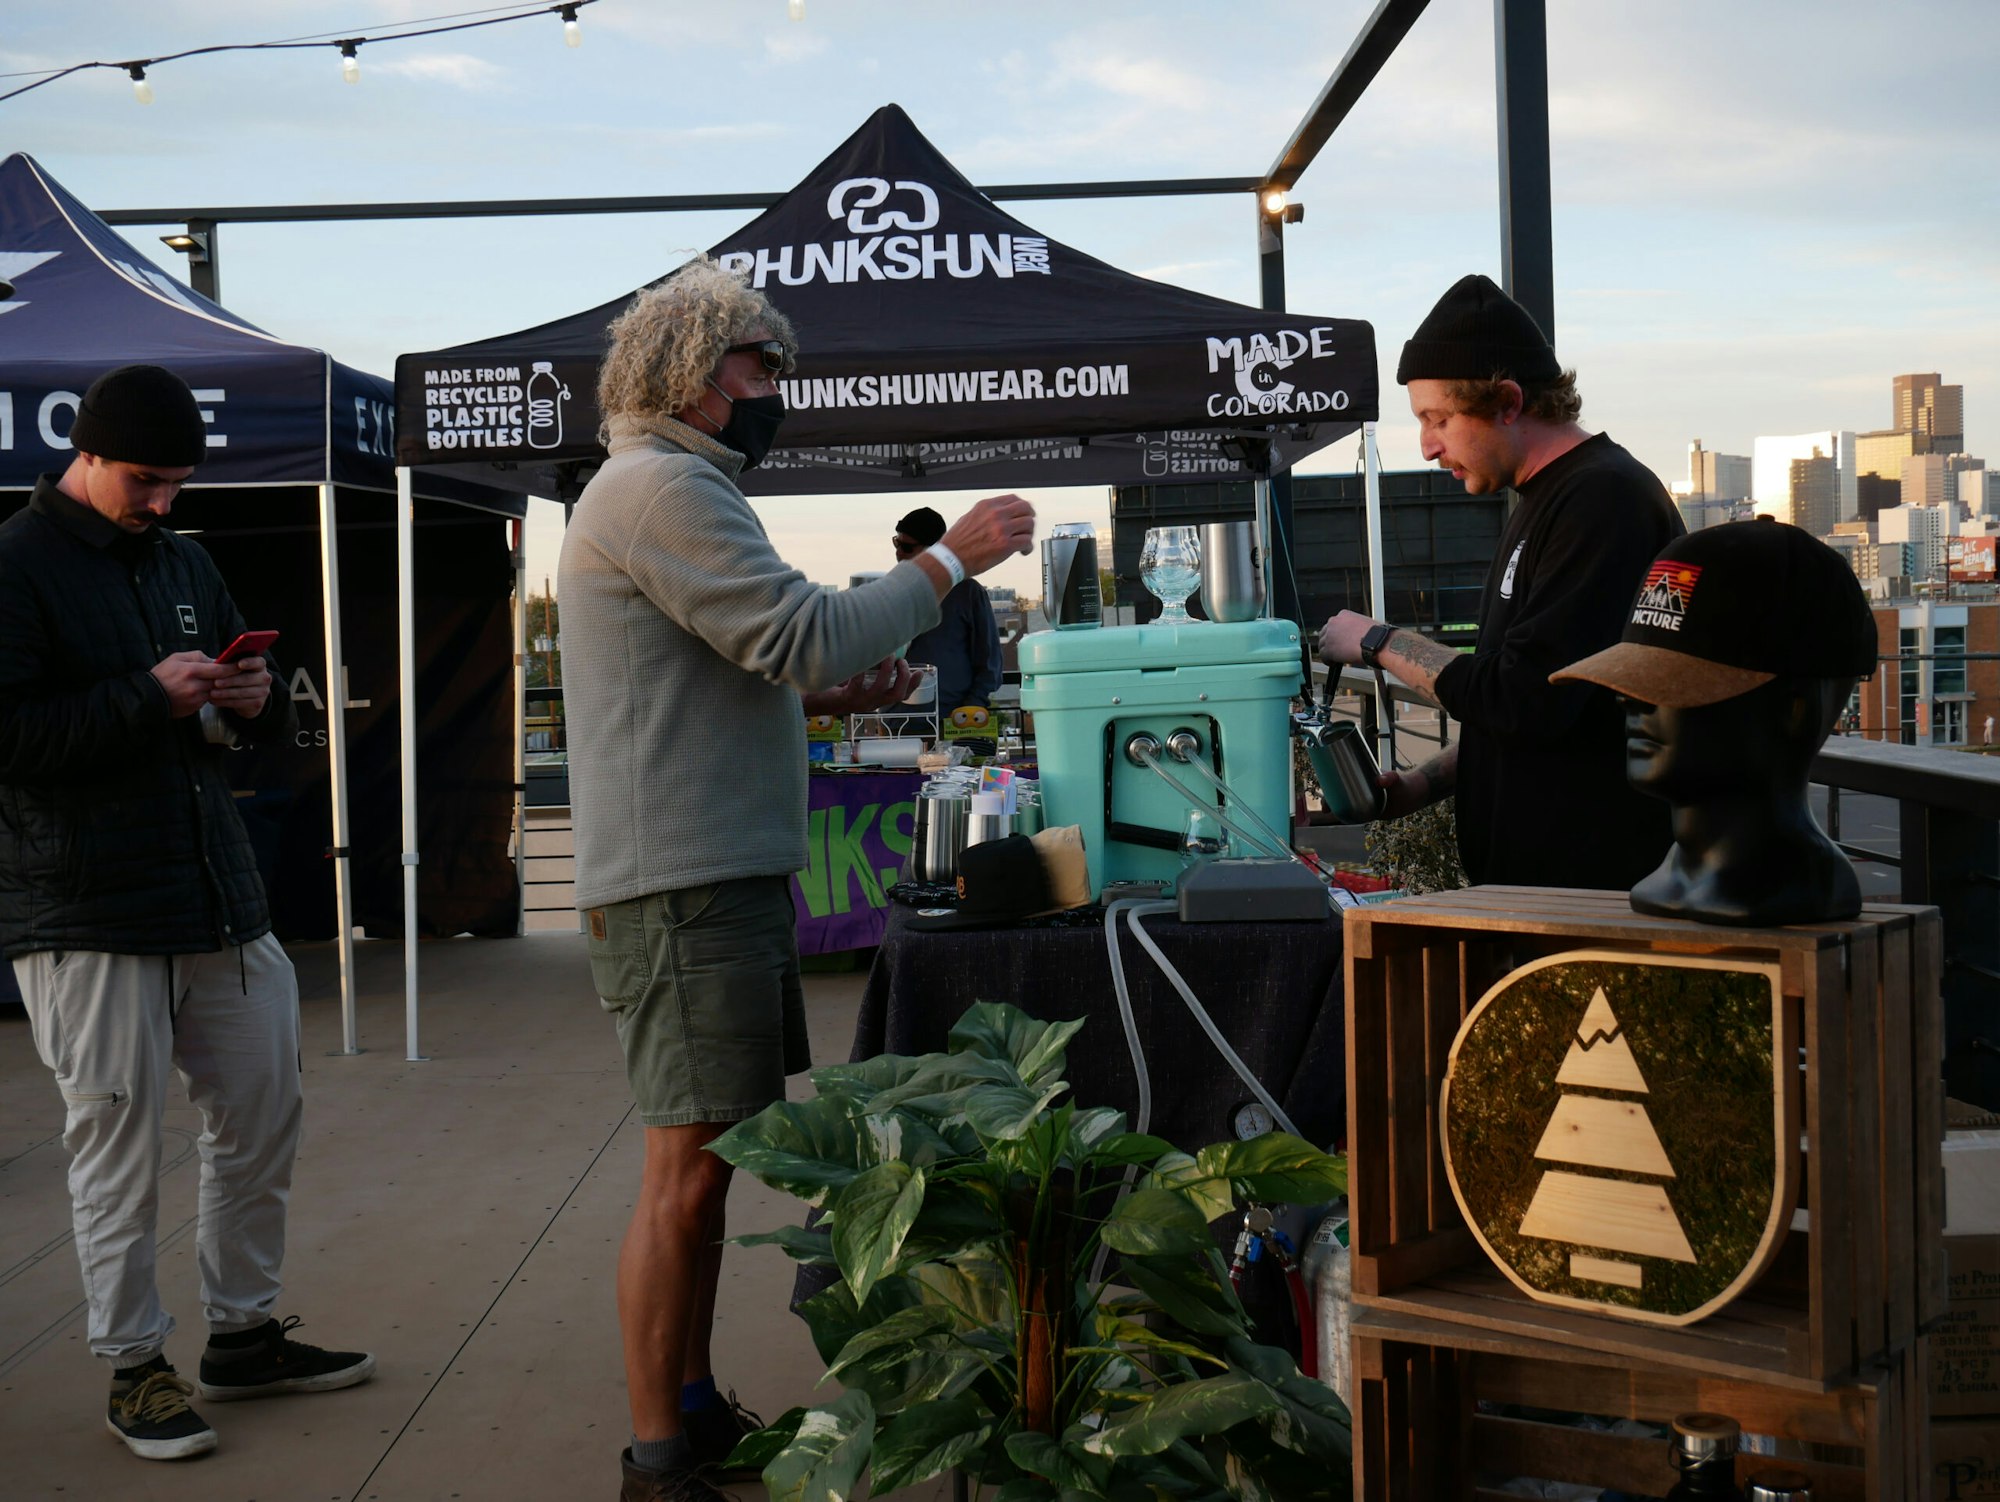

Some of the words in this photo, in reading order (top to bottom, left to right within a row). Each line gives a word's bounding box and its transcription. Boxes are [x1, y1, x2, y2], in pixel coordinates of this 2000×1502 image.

[719, 233, 1014, 288] PHUNKSHUN
[1206, 327, 1336, 373] MADE
[424, 369, 472, 385] MADE
[476, 367, 521, 383] FROM
[1258, 370, 1273, 384] in
[425, 386, 523, 406] RECYCLED
[1207, 390, 1349, 417] COLORADO
[426, 405, 523, 428] PLASTIC
[427, 428, 524, 450] BOTTLES
